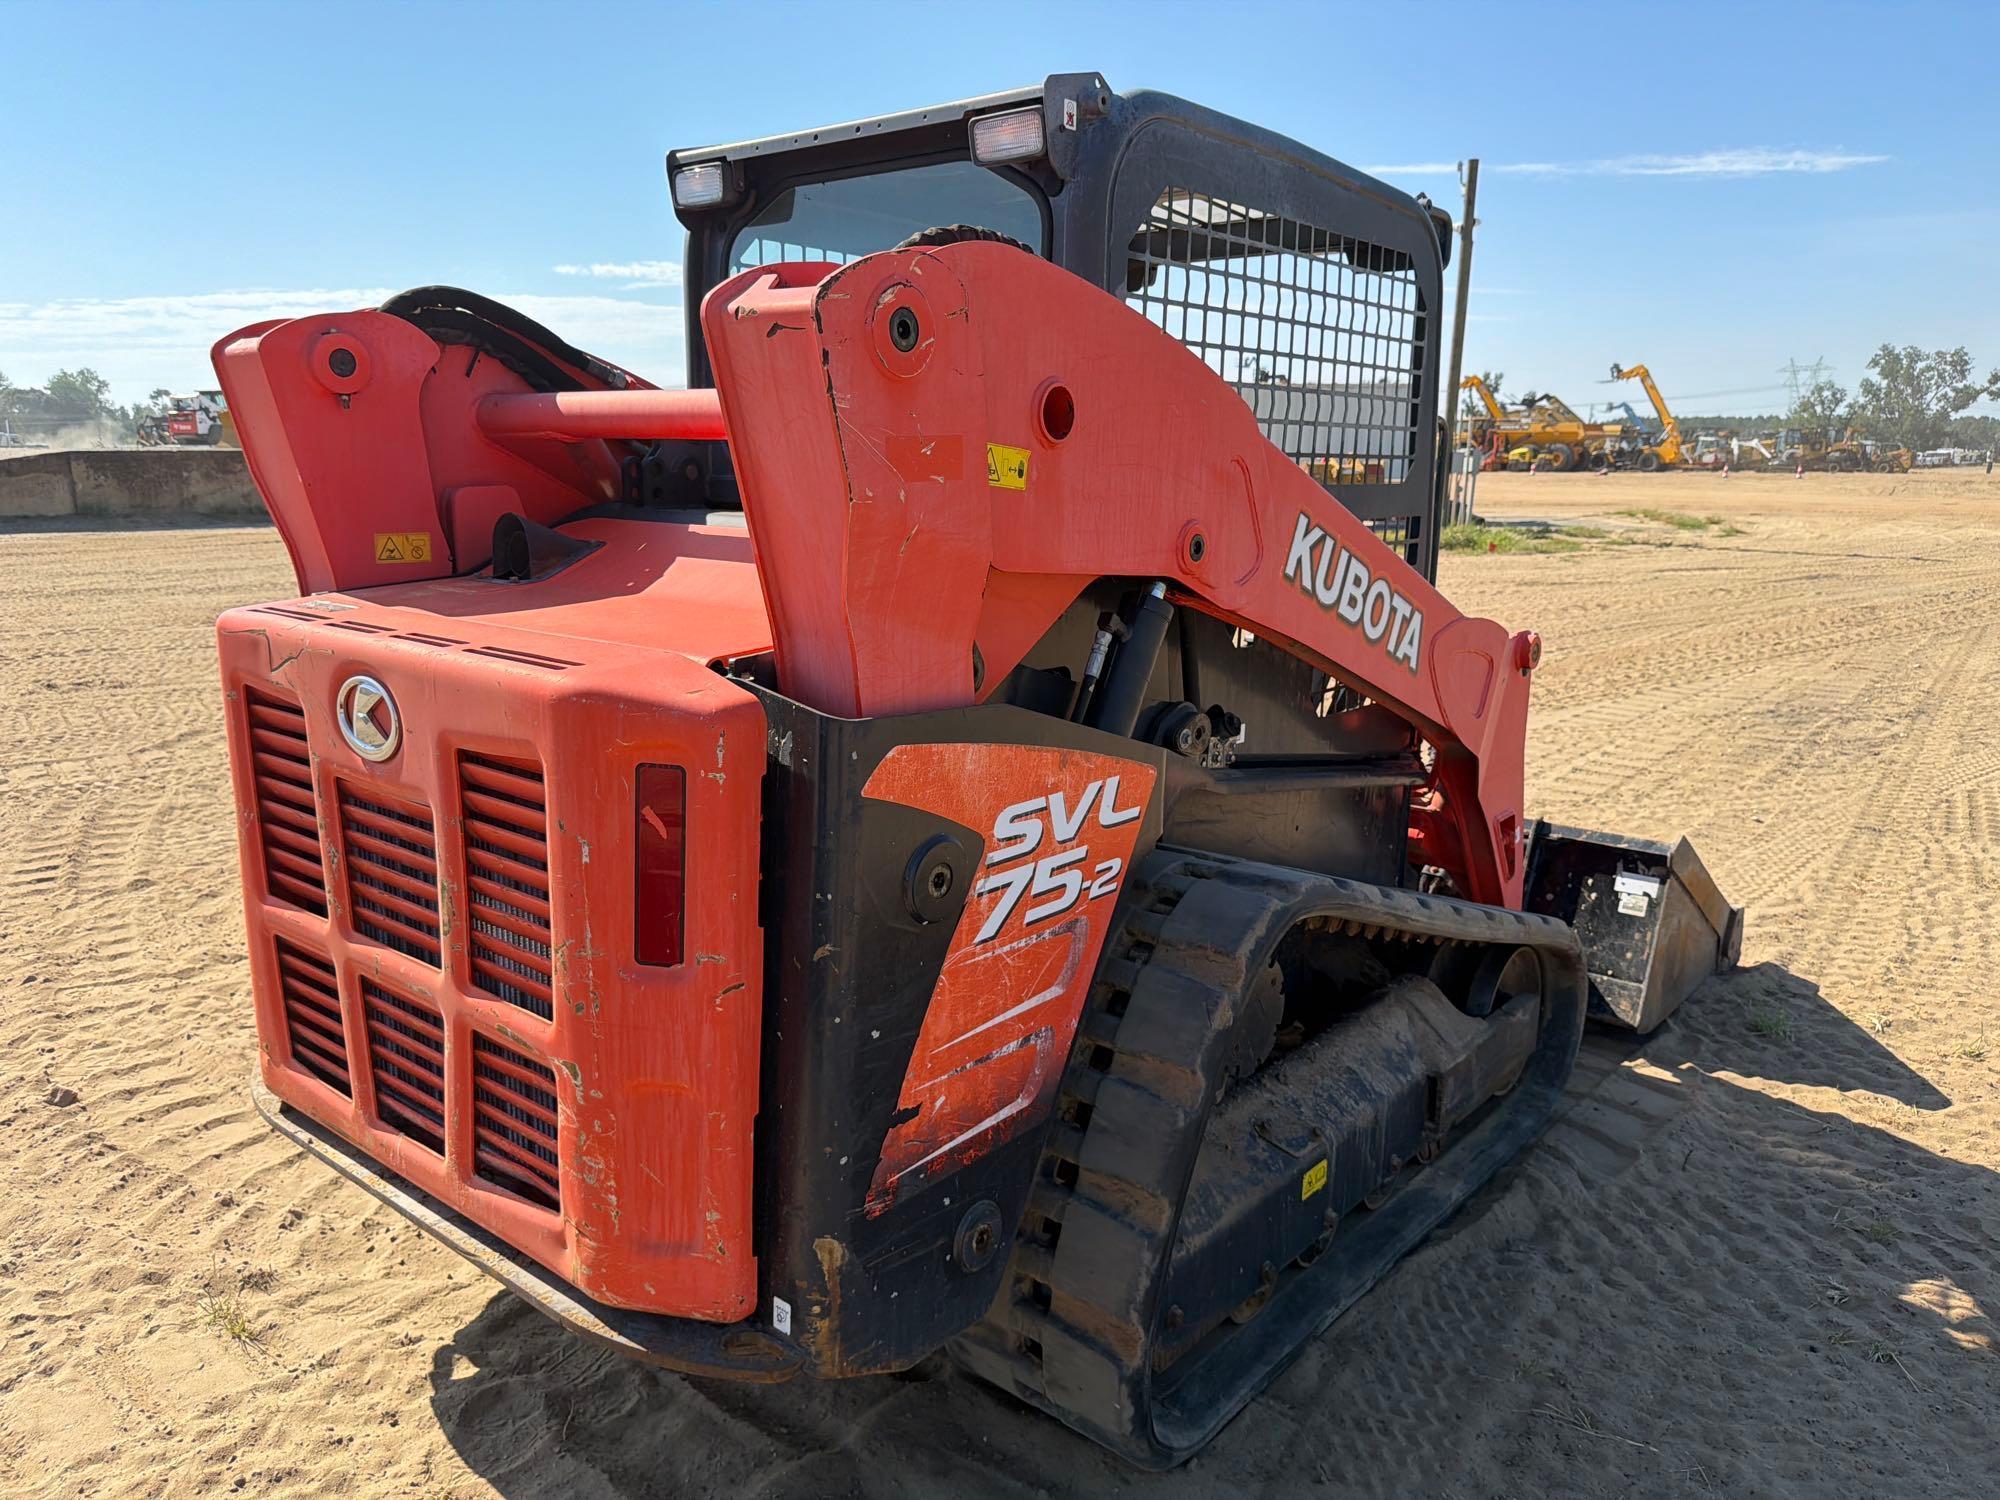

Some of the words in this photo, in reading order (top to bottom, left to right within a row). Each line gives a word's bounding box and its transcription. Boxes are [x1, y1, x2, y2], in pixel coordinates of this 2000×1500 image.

[1284, 512, 1422, 671] KUBOTA
[985, 775, 1141, 868] SVL
[973, 845, 1122, 945] 75-2
